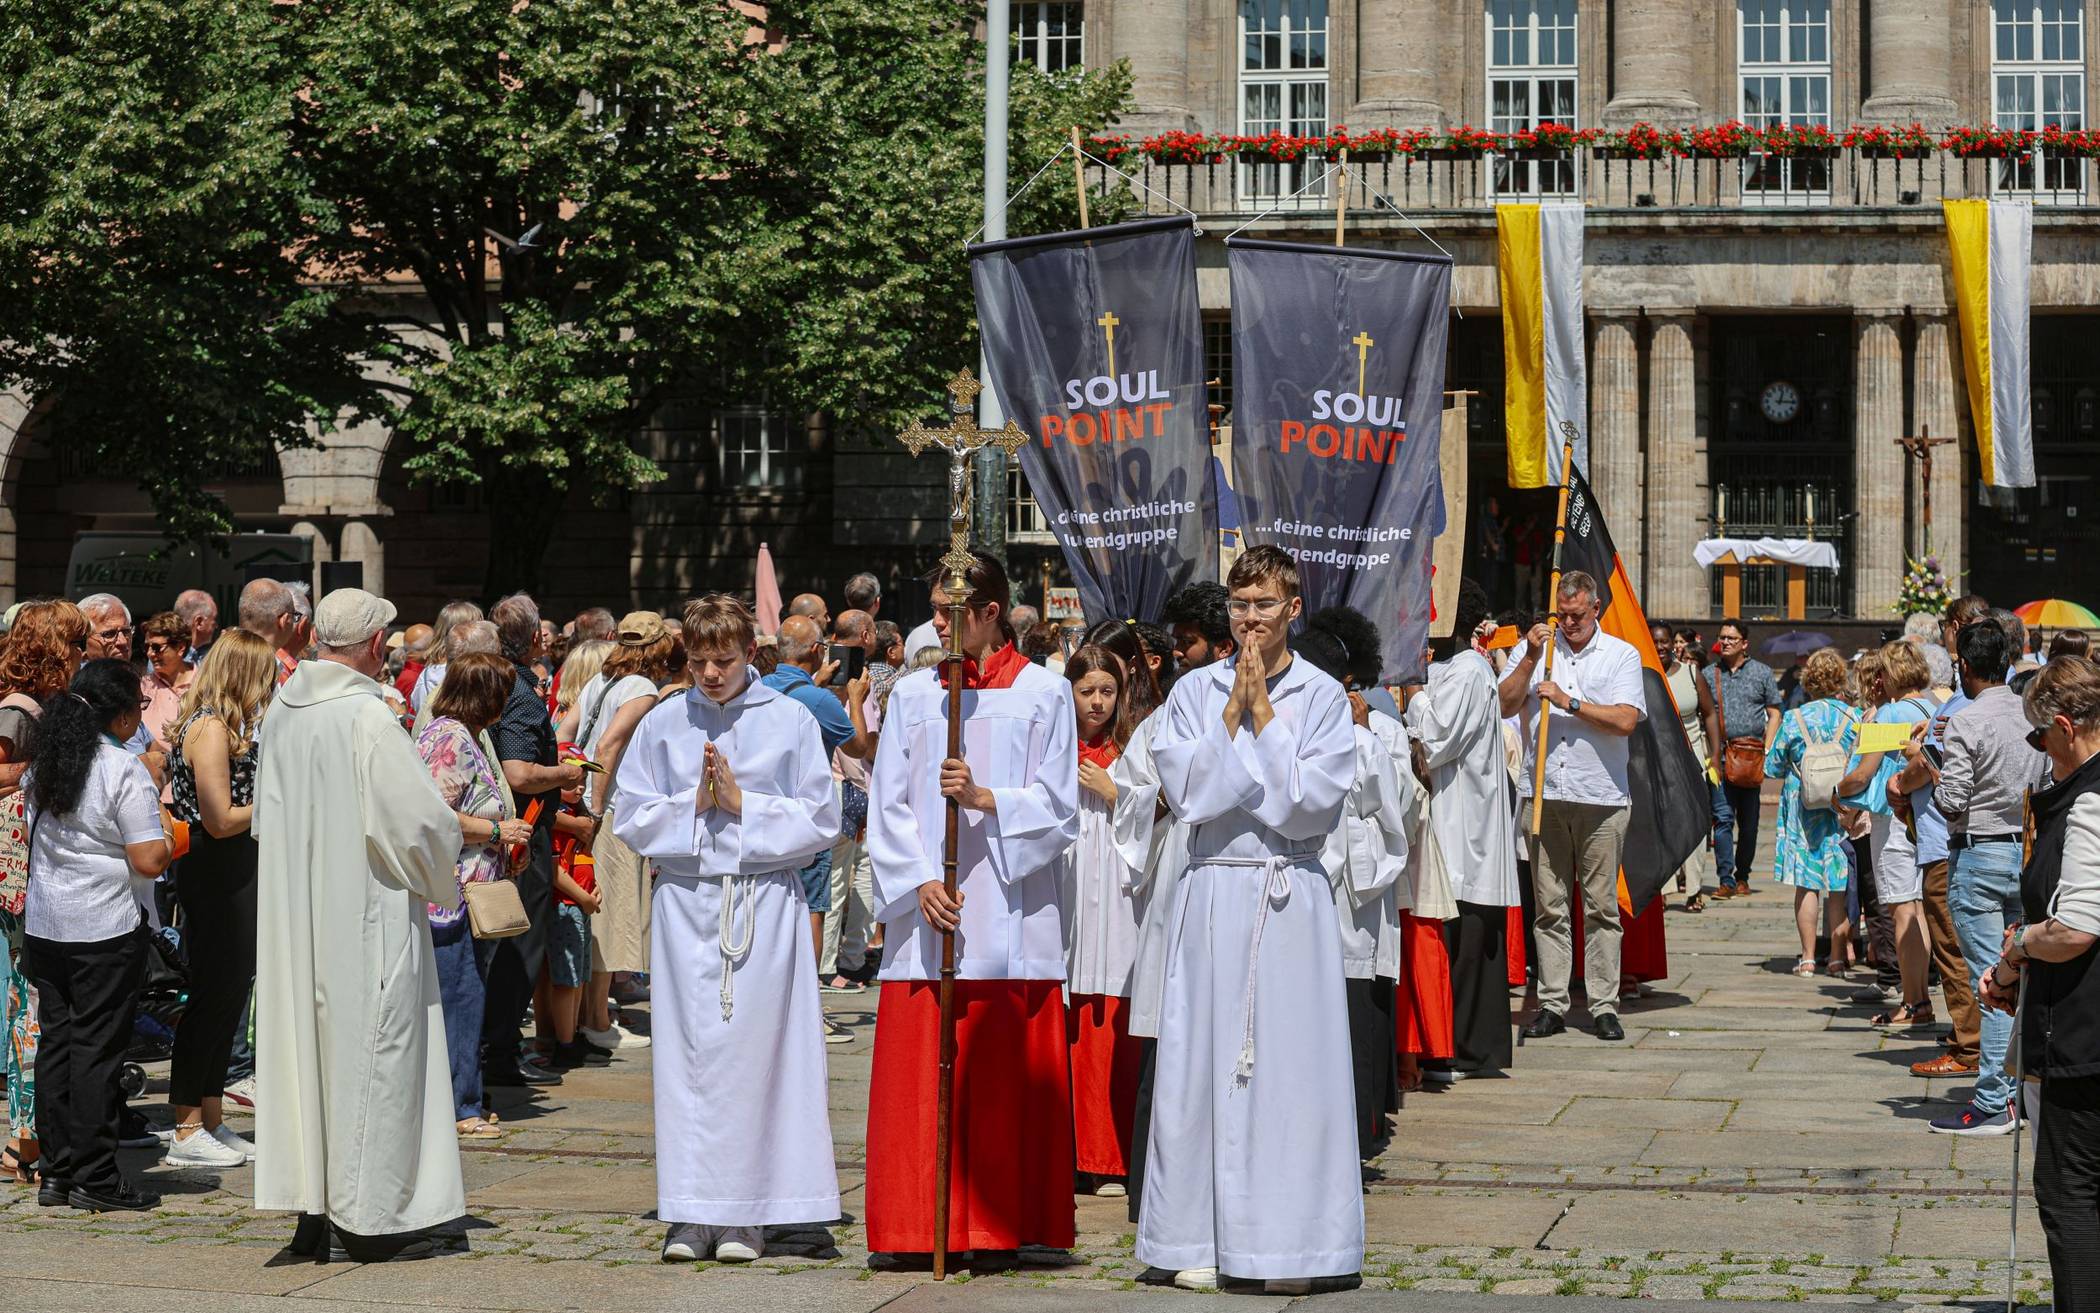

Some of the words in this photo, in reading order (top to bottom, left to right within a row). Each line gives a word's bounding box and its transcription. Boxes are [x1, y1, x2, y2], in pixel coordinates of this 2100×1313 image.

[1065, 370, 1170, 410] SOUL
[1312, 389, 1406, 429] SOUL
[1039, 402, 1174, 449] POINT
[1279, 420, 1407, 465] POINT
[1102, 499, 1196, 522] christliche
[1327, 524, 1412, 543] christliche
[1276, 542, 1390, 571] gendgruppe
